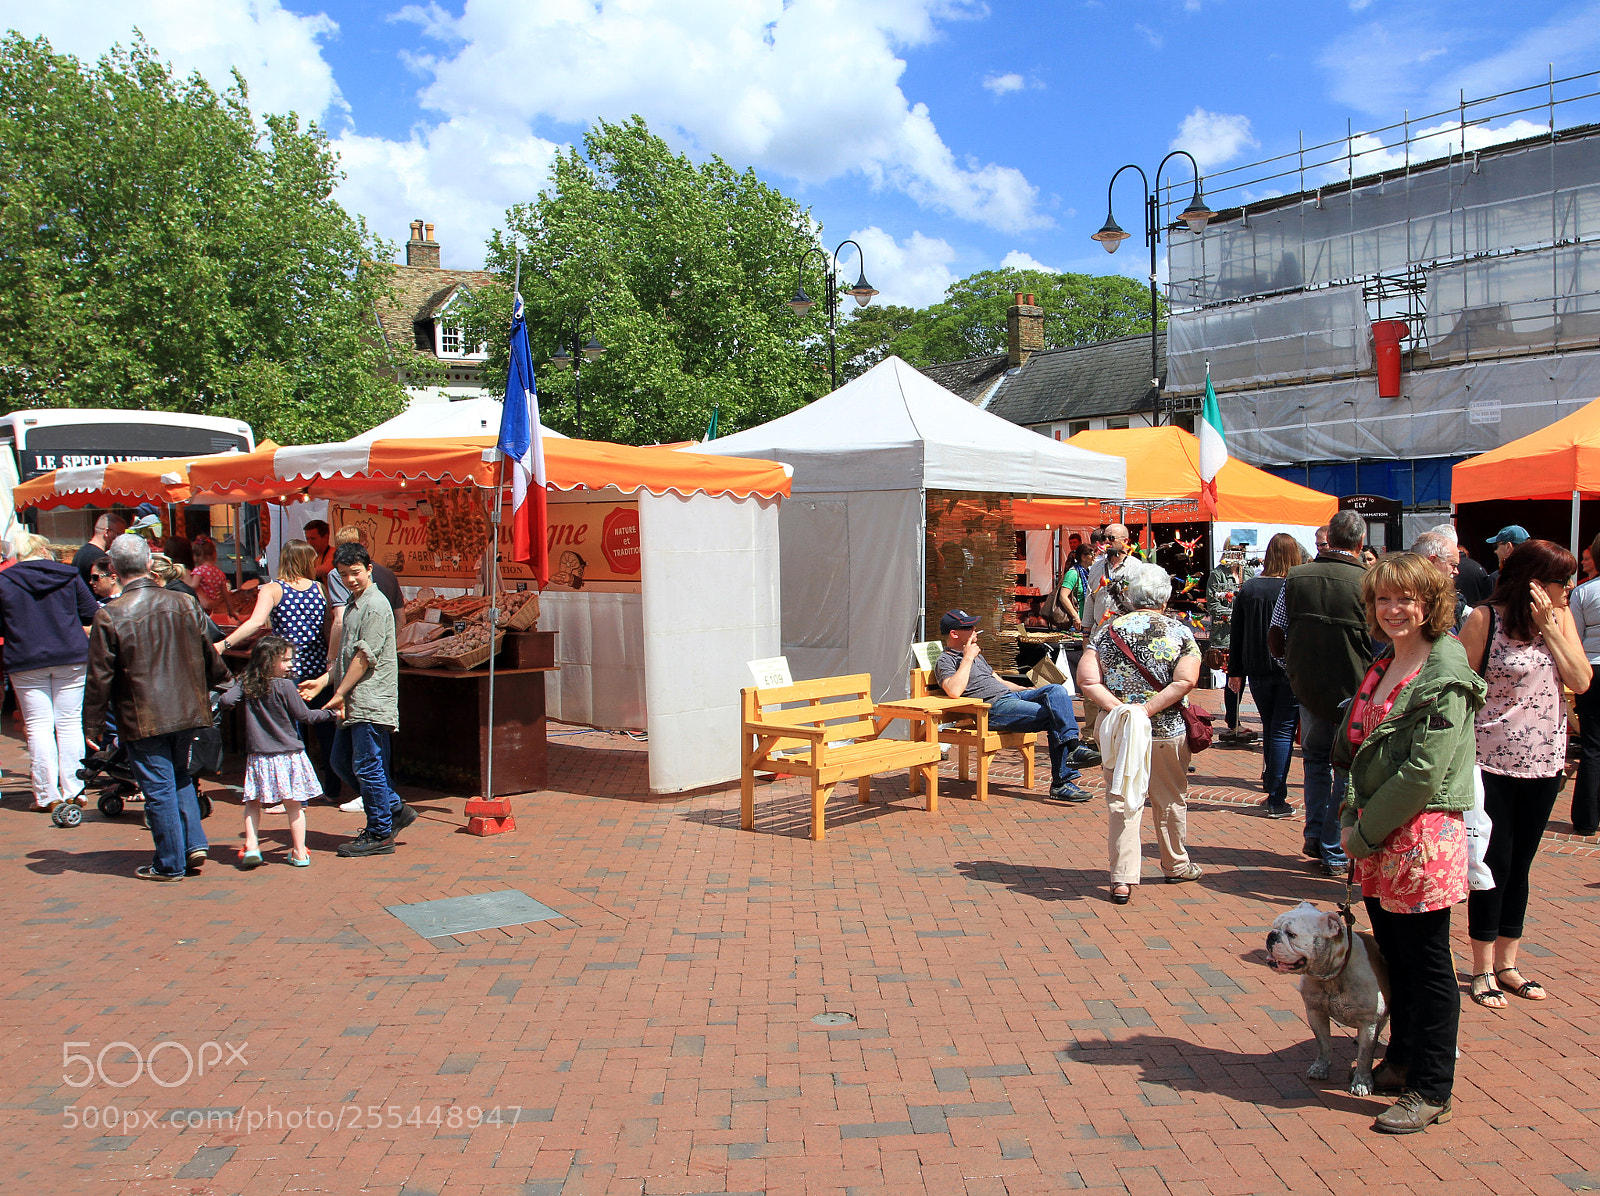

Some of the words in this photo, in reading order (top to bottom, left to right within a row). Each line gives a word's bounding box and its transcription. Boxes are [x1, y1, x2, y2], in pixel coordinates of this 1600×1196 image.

[35, 455, 57, 470] LE
[61, 455, 158, 469] SPECIALIS
[614, 525, 637, 536] NATURE
[622, 537, 631, 545] et
[612, 546, 641, 557] TRADITIO
[764, 673, 784, 686] £109
